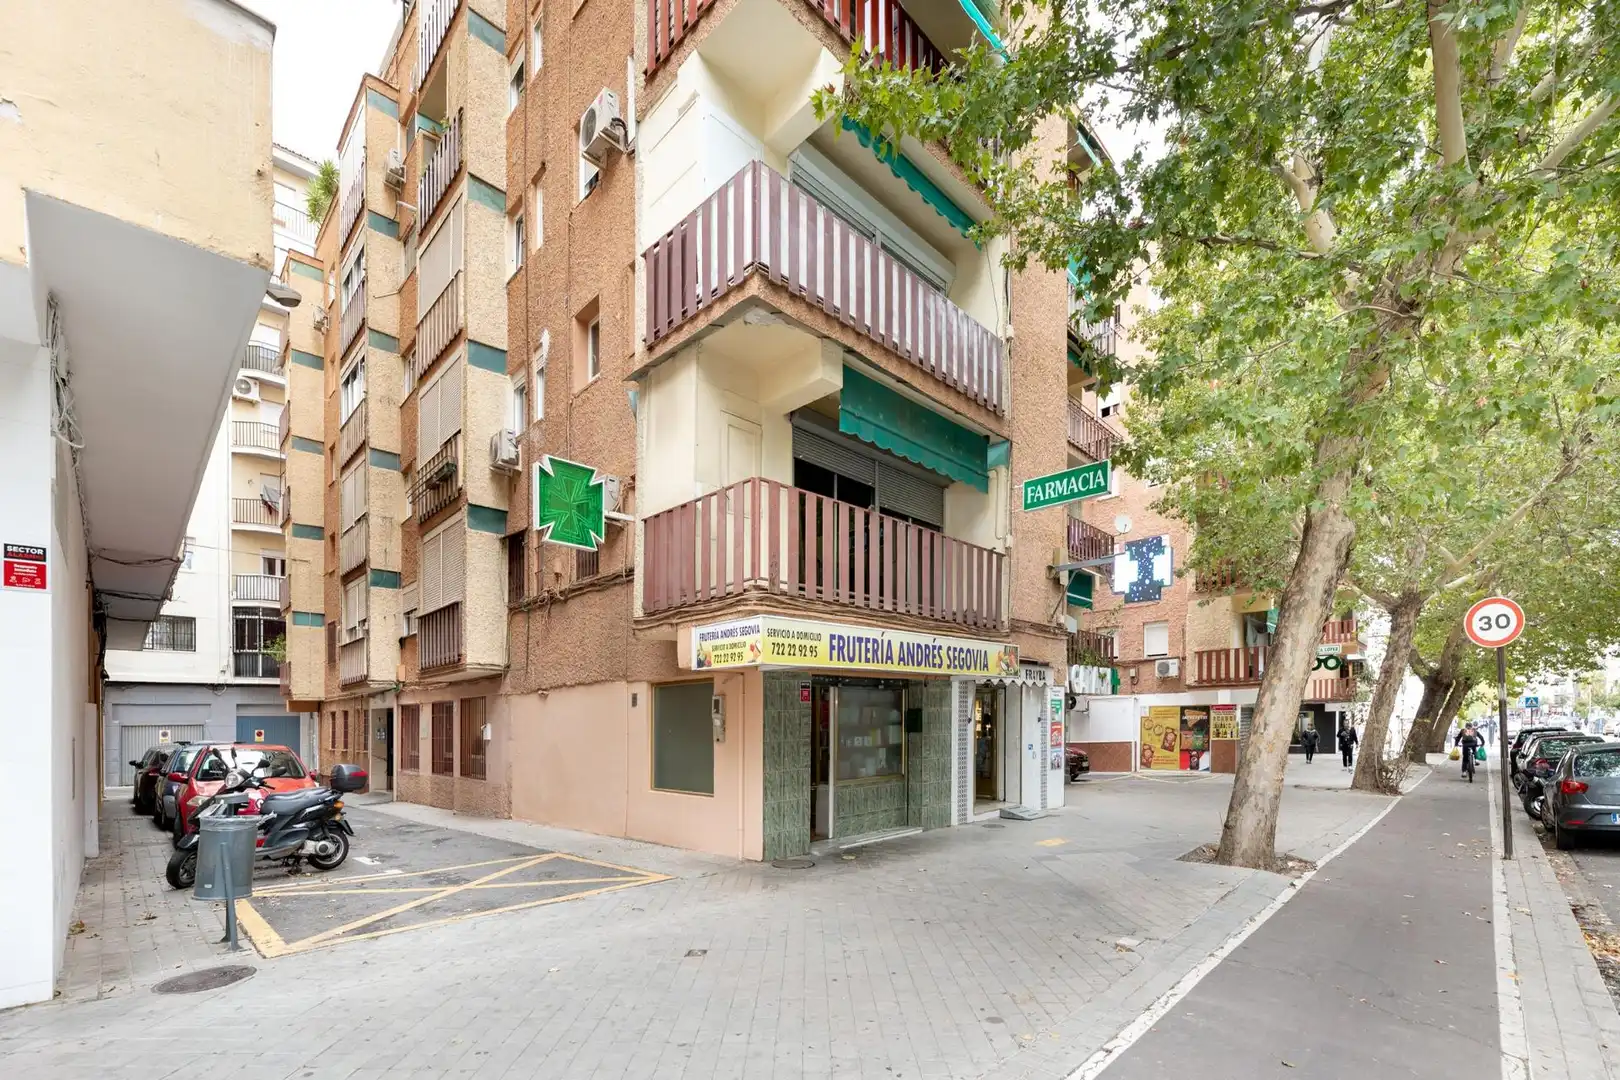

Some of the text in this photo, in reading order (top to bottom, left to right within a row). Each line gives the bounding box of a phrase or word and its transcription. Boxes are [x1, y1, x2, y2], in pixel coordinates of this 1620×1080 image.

[1027, 469, 1106, 504] FARMACIA
[6, 545, 44, 555] SECTOR
[1478, 613, 1511, 631] 30
[720, 626, 739, 639] ANDRÉS
[739, 624, 761, 637] SEGOVIA
[767, 627, 822, 642] SERVICIO A DOMICILIO
[713, 651, 744, 664] 722 22 92 95
[771, 642, 818, 658] 722 22 92 95
[829, 631, 989, 672] FRUTERÍA ANDRÉS SEGOVIA
